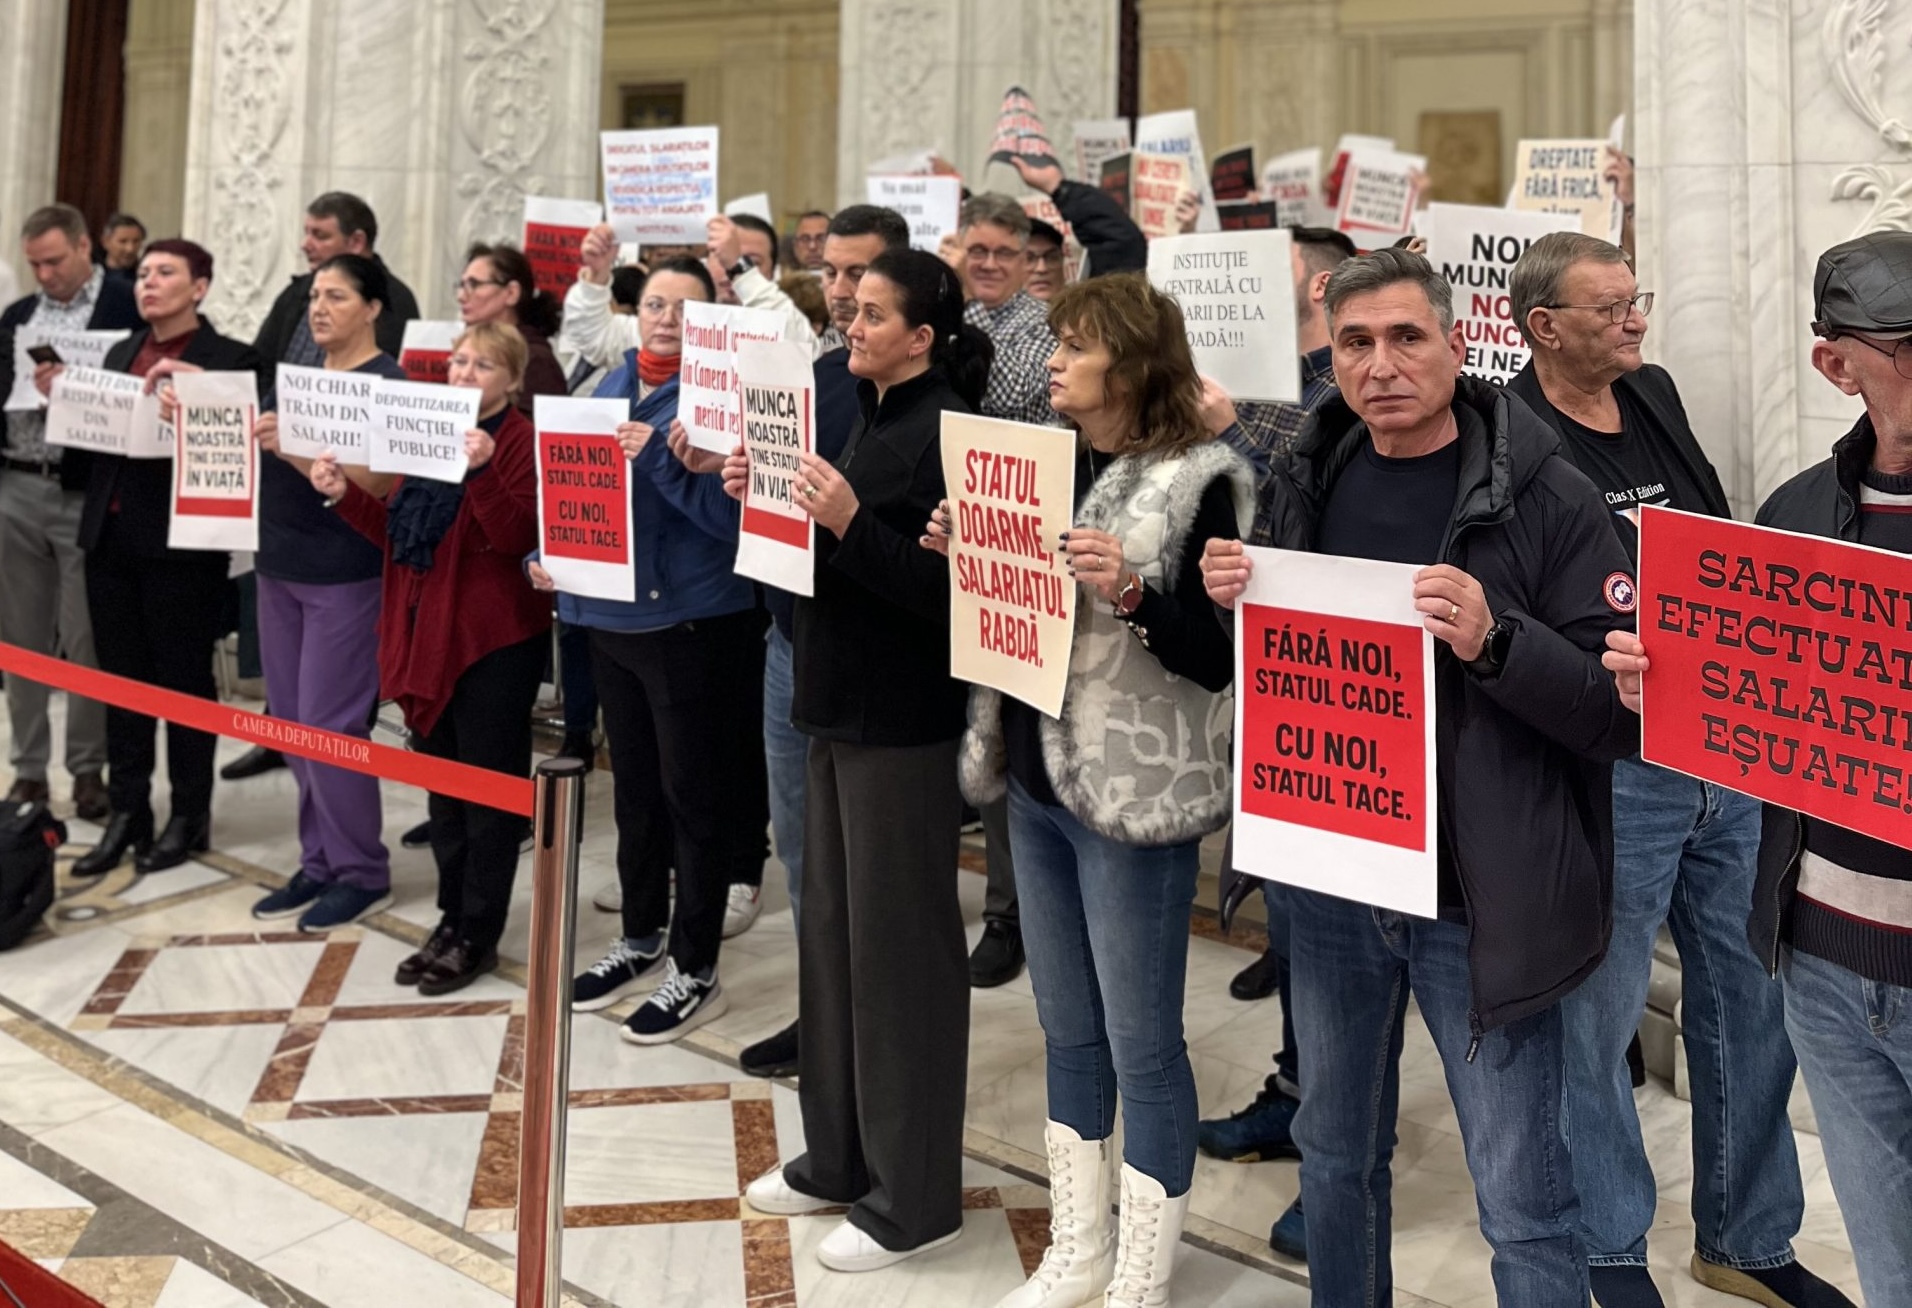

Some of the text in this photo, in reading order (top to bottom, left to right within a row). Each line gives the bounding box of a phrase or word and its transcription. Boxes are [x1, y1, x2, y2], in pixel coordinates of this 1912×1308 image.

[1529, 147, 1598, 170] DREPTATE
[1173, 251, 1249, 271] INSTITUȚIE
[1164, 275, 1262, 296] CENTRALĂ CU
[1442, 262, 1511, 289] MUN
[1217, 304, 1238, 321] DE
[1242, 304, 1265, 320] LA
[685, 318, 727, 352] Personalul
[284, 373, 372, 397] NOI CHIAR
[694, 360, 727, 392] Camera
[114, 397, 134, 411] NU
[284, 398, 371, 423] TRĂIM DIN
[374, 392, 471, 415] DEPOLITIZAREA
[746, 387, 798, 420] MUNCA
[84, 411, 109, 426] DIN
[187, 406, 244, 427] MUNCA
[386, 415, 455, 438] FUNCȚIEI
[695, 402, 725, 432] merită
[291, 424, 361, 448] SALARII!
[211, 452, 246, 465] STATUL
[389, 438, 456, 461] PUBLICE!
[588, 447, 617, 469] NOI,
[547, 469, 621, 490] STATUL CADE.
[965, 448, 1040, 507] STATUL
[1627, 489, 1637, 501] X
[1636, 483, 1666, 499] Edition
[558, 500, 610, 526] CU NOI,
[549, 525, 622, 548] STATUL TACE.
[958, 500, 1055, 570] DOARME,
[957, 552, 1067, 621] SALARIATUL
[1341, 638, 1402, 683] NOI,
[1255, 668, 1413, 720] STATUL CADE.
[233, 712, 370, 764] CAMERA DEPUTAȚILOR
[1275, 723, 1388, 779] CU NOI,
[1253, 762, 1412, 821] STATUL TACE.
